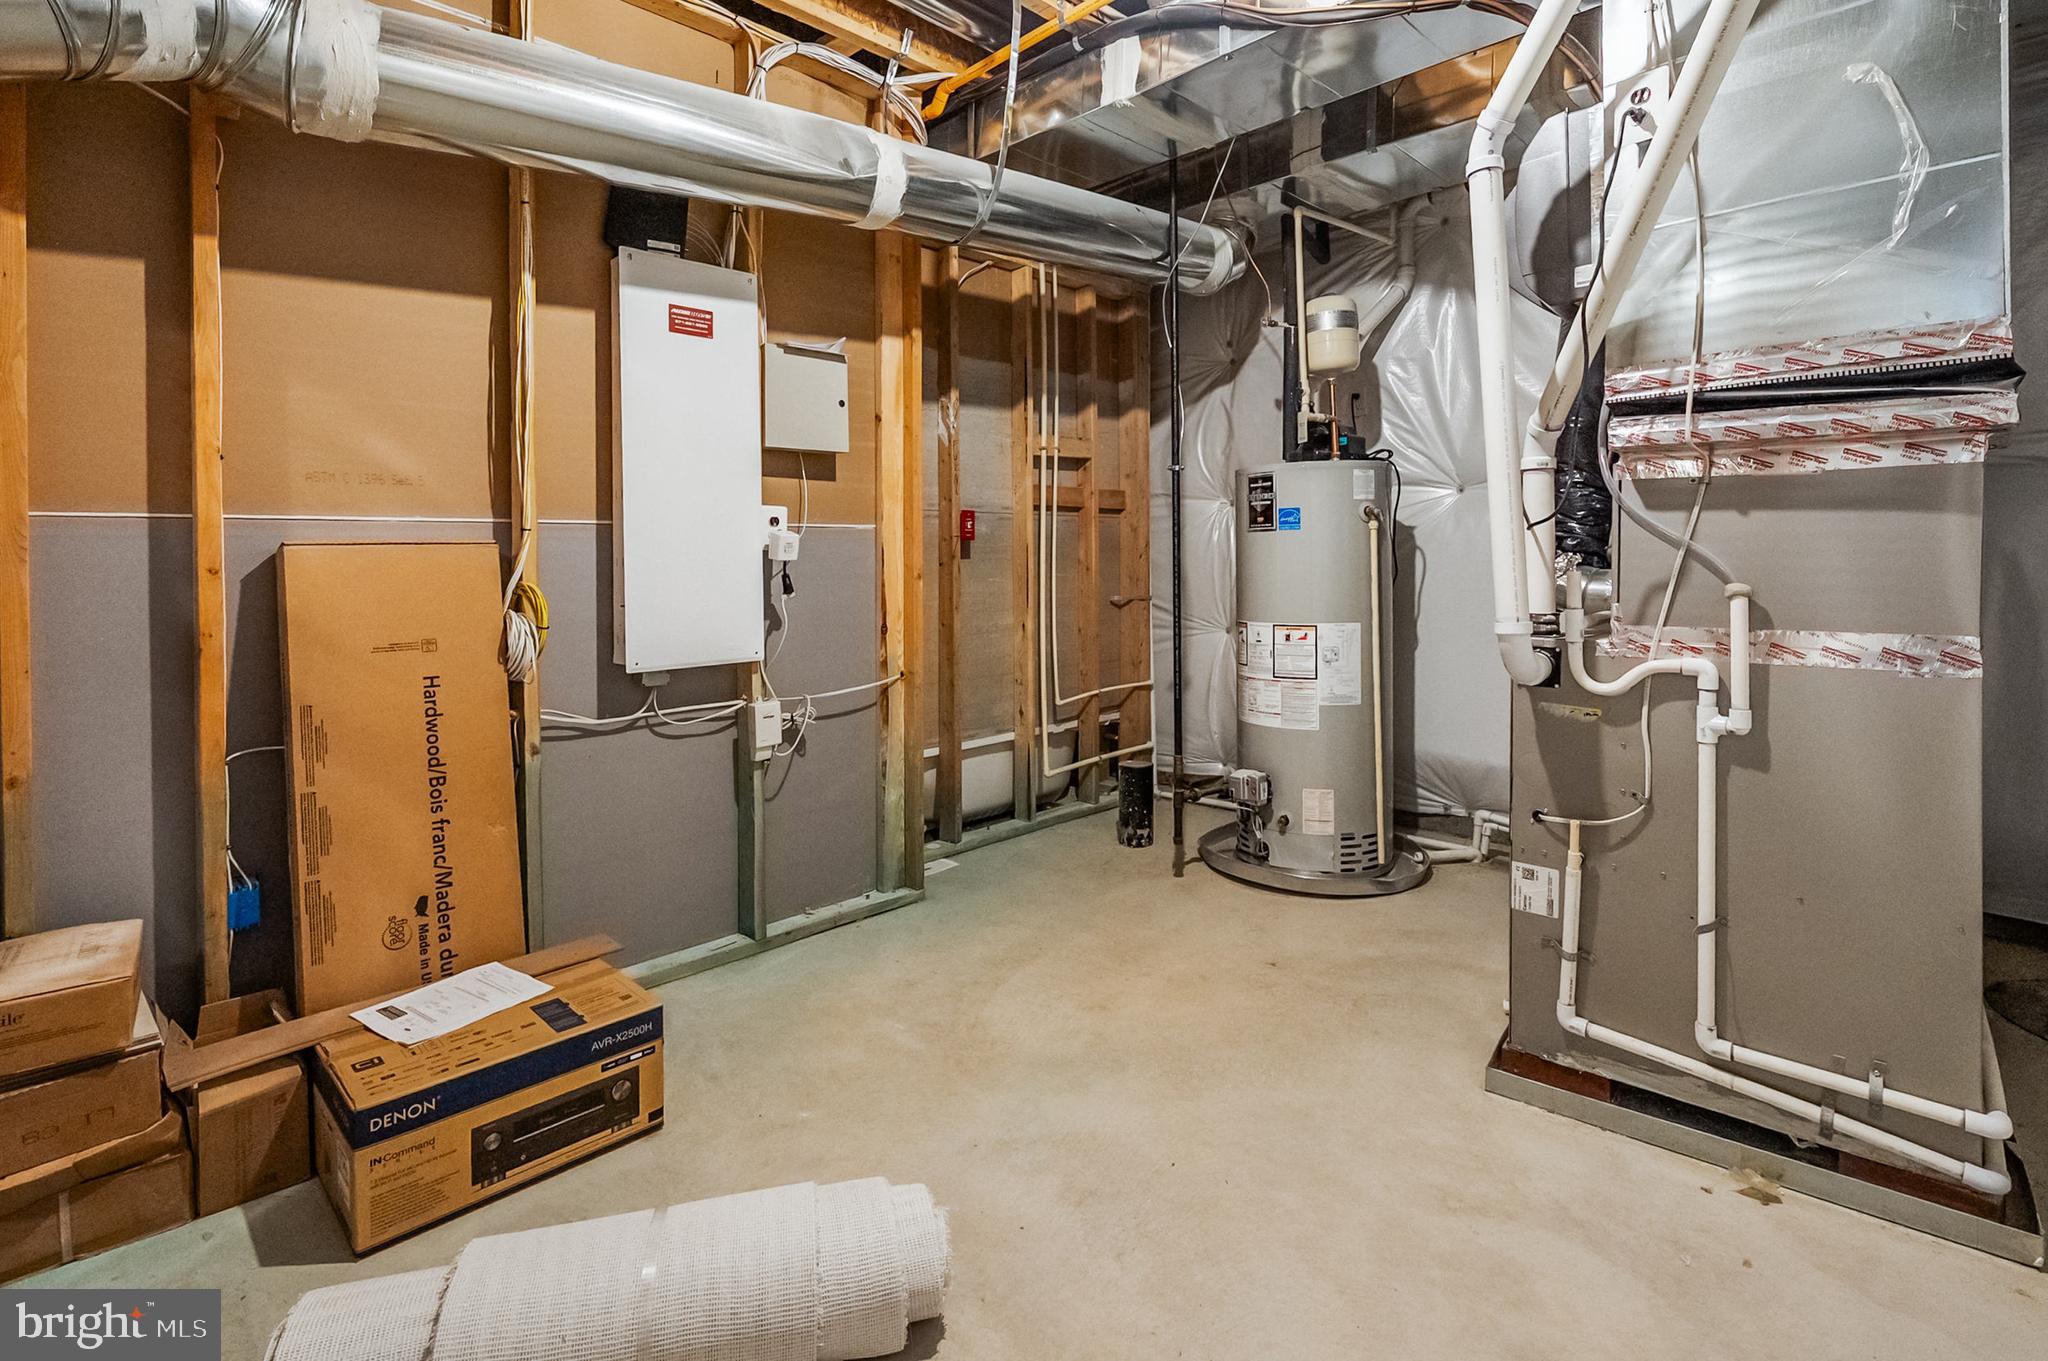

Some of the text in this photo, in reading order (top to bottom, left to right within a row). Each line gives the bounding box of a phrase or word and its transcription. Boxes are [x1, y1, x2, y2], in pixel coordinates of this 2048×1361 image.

[422, 675, 448, 814] Hardwood/Bois
[431, 818, 456, 943] franc/Madera
[418, 923, 431, 956] Made
[420, 958, 431, 970] in
[591, 1021, 653, 1053] AVR-X2500H
[369, 1098, 436, 1133] DENON
